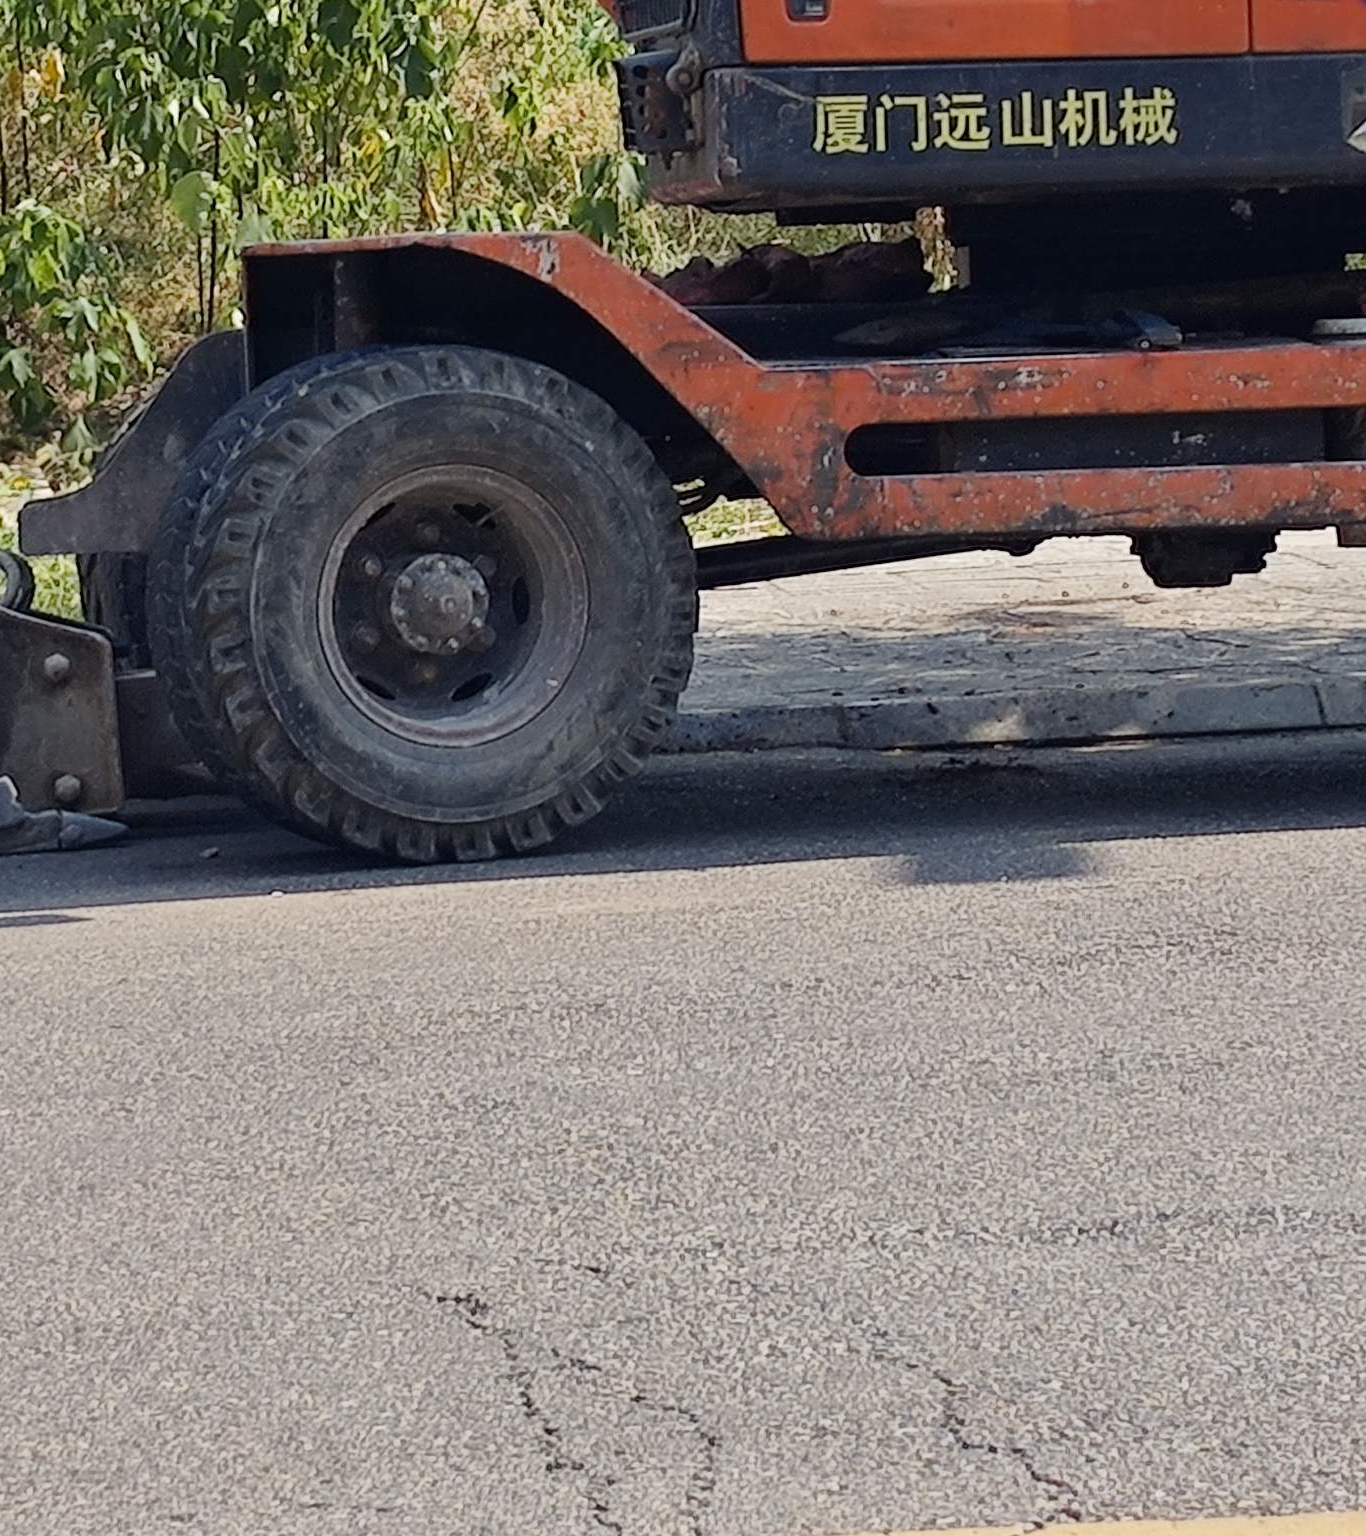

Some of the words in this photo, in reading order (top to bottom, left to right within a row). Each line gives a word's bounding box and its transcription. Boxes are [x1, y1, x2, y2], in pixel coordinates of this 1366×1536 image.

[812, 86, 1180, 154] 厦门远山机械
